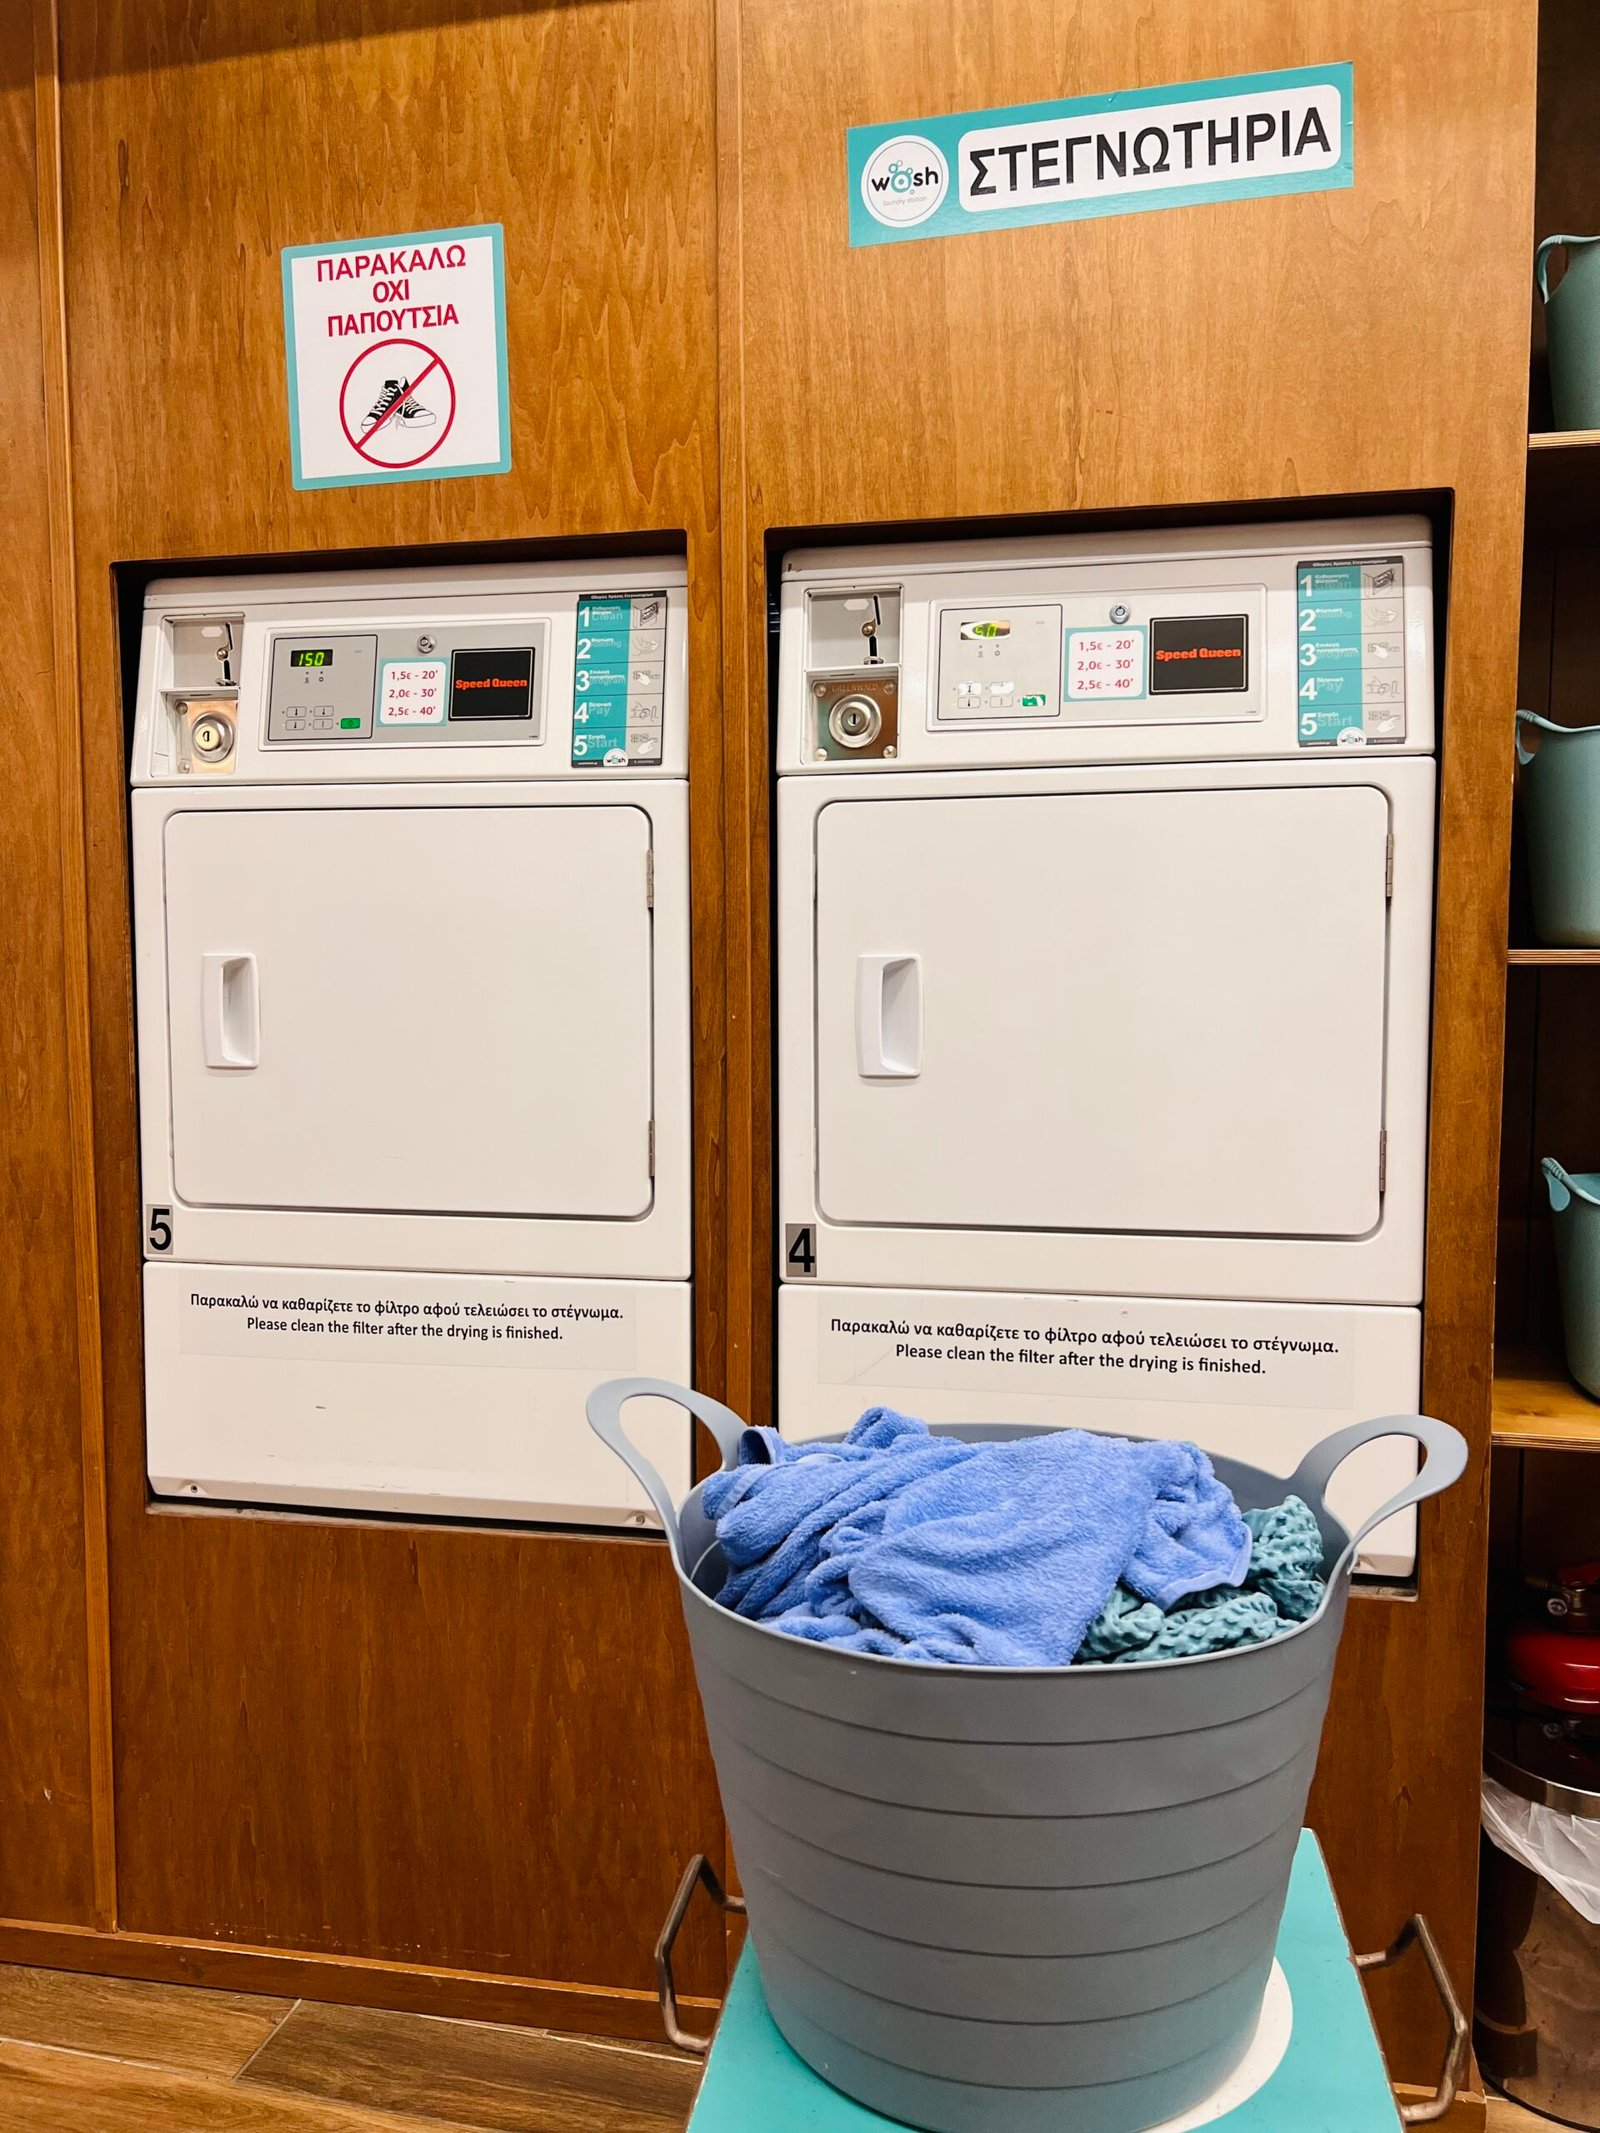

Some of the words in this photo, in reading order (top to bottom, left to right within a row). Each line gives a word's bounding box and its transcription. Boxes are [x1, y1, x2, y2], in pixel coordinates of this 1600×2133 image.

[969, 107, 1332, 197] ΣΤΕΓΝΩΤΗΡΙΑ
[317, 244, 467, 282] ΠΑΡΑΚΑΛΩ
[372, 279, 410, 303] ΟΧΙ
[327, 304, 459, 337] ΠΑΠΟΥΤΣΙΑ
[1300, 574, 1312, 597] 1
[579, 606, 590, 627] 1
[1299, 608, 1317, 632] 2
[577, 638, 591, 659] 2
[1079, 641, 1103, 652] 1,5€
[1155, 648, 1197, 662] Speed
[1199, 648, 1242, 658] Queen
[1300, 643, 1317, 666] 3
[298, 652, 325, 667] 150
[1077, 660, 1103, 671] 2,0€
[391, 671, 411, 681] 1,5€
[455, 679, 490, 690] Speed
[492, 678, 528, 687] Queen
[576, 670, 590, 691] 3
[1077, 680, 1103, 691] 2,5€
[389, 689, 410, 699] 2,0€
[1299, 677, 1318, 701] 4
[388, 707, 409, 717] 2,5€
[573, 702, 589, 724] 4
[588, 705, 611, 717] Pay
[1300, 712, 1318, 736] 5
[573, 734, 588, 756] 5
[150, 1208, 172, 1251] 5
[789, 1228, 815, 1272] 4
[190, 1293, 259, 1309] Παρακαλώ
[262, 1300, 279, 1309] να
[282, 1297, 353, 1314] καθαρίζετε
[357, 1303, 371, 1313] το
[374, 1299, 419, 1317] φίλτρο
[423, 1302, 460, 1318] αφού
[464, 1303, 529, 1317] τελειώσει
[533, 1308, 547, 1317] το
[551, 1304, 624, 1321] στέγνωμα.
[247, 1317, 287, 1331] Please
[291, 1318, 324, 1332] clean
[328, 1320, 349, 1333] the
[353, 1321, 384, 1335] filter
[387, 1322, 418, 1336] after
[422, 1323, 443, 1337] the
[447, 1324, 488, 1341] drying
[492, 1325, 502, 1339] is
[506, 1326, 563, 1340] finished.
[831, 1318, 909, 1335] Παρακαλώ
[914, 1325, 932, 1336] να
[937, 1323, 1019, 1341] καθαρίζετε
[1024, 1330, 1040, 1341] το
[1044, 1327, 1097, 1346] φίλτρο
[1101, 1331, 1145, 1347] αφού
[1150, 1332, 1227, 1349] τελειώσει
[1231, 1338, 1248, 1350] το
[1253, 1336, 1339, 1355] στέγνωμα.
[896, 1344, 942, 1359] Please
[946, 1346, 985, 1361] clean
[990, 1348, 1014, 1362] the
[1019, 1349, 1055, 1364] filter
[1059, 1351, 1095, 1366] after
[1099, 1353, 1124, 1368] the
[1129, 1354, 1178, 1373] drying
[1182, 1357, 1194, 1371] is
[1199, 1357, 1266, 1374] finished.
